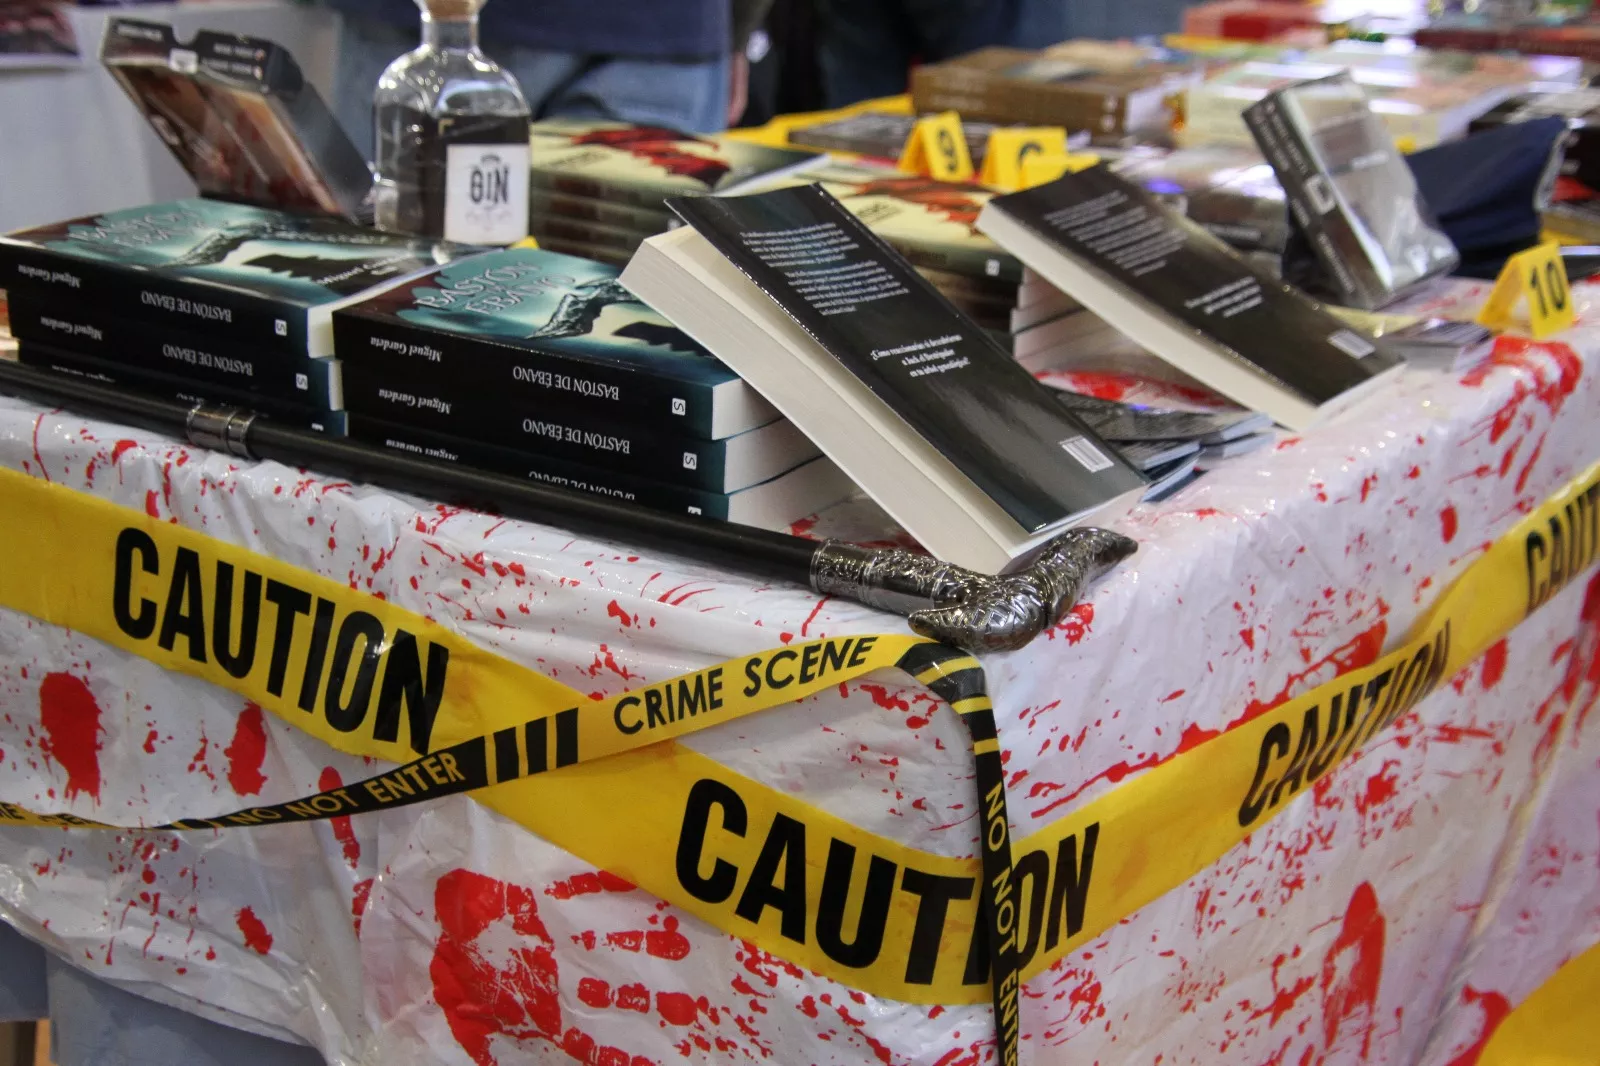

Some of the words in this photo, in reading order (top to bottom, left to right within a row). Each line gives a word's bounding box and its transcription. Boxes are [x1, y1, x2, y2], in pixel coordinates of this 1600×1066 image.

[937, 128, 958, 173] 9
[1530, 259, 1566, 319] 10
[176, 298, 191, 314] DE
[370, 335, 407, 355] Gardeta
[408, 345, 442, 363] Miguel
[197, 350, 212, 368] DE
[512, 365, 552, 388] ÉBANO
[554, 374, 571, 391] DE
[379, 388, 415, 409] Gardeta
[573, 379, 620, 400] BASTÓN
[417, 397, 452, 415] Miguel
[522, 418, 563, 441] ÉBANO
[565, 428, 581, 444] DE
[583, 432, 630, 454] BASTÓN
[113, 527, 450, 755] CAUTION
[614, 667, 723, 736] CRIME
[743, 636, 879, 698] SCENE
[1237, 617, 1451, 828] CAUTION
[286, 790, 360, 820] NOT
[364, 752, 466, 804] ENTER
[986, 781, 1006, 852] NO
[992, 868, 1016, 956] NOT
